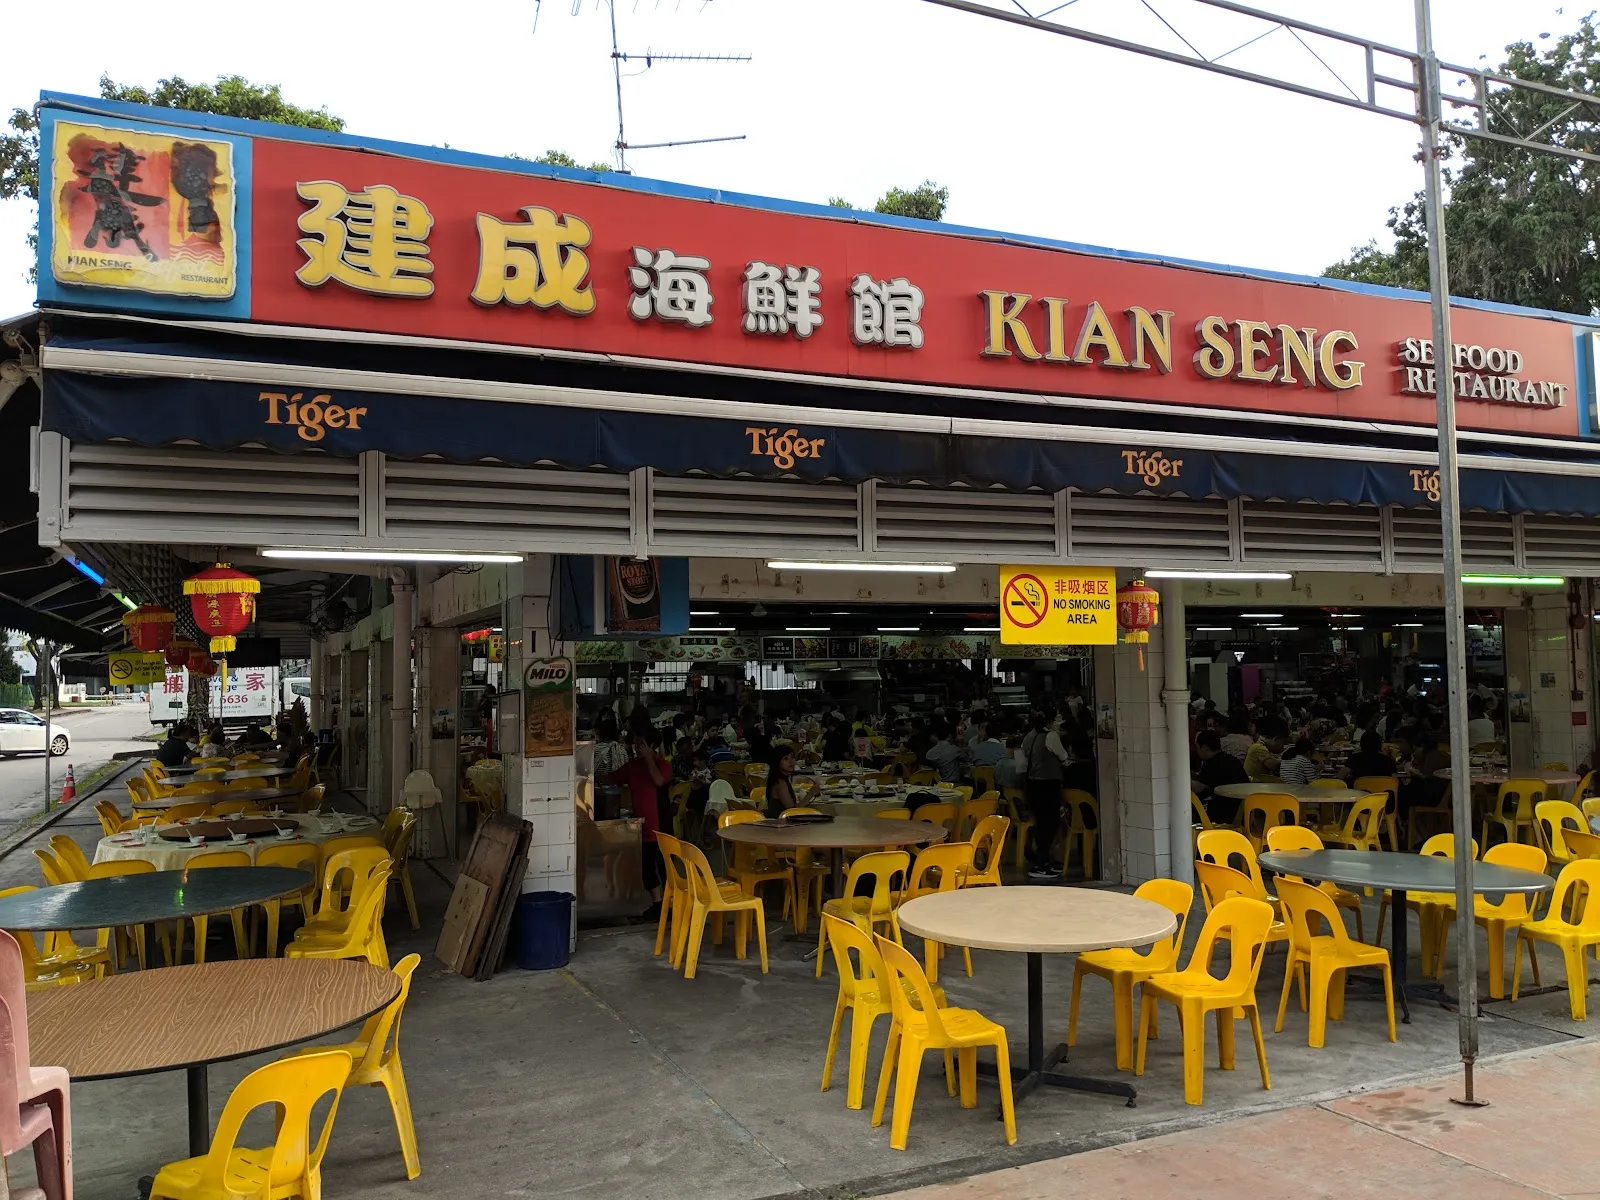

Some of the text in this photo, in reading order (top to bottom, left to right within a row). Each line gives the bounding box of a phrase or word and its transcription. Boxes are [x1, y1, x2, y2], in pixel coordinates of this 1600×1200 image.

[180, 274, 229, 285] RESTAURANT
[296, 180, 597, 317] 建成
[628, 246, 925, 350] 海鮮館
[978, 289, 1366, 390] KIAN SENG
[1403, 337, 1524, 375] SEFOOD
[1404, 366, 1570, 408] RETAURANT
[259, 392, 367, 442] Tiger
[746, 427, 825, 469] Tiger
[1121, 449, 1183, 488] Tiger
[1409, 469, 1442, 502] Tig
[1053, 599, 1111, 610] NO SMOKING
[1054, 579, 1109, 595] 非吸烟区
[1067, 614, 1097, 625] AREA
[245, 672, 266, 691] 家
[530, 667, 566, 680] MILO
